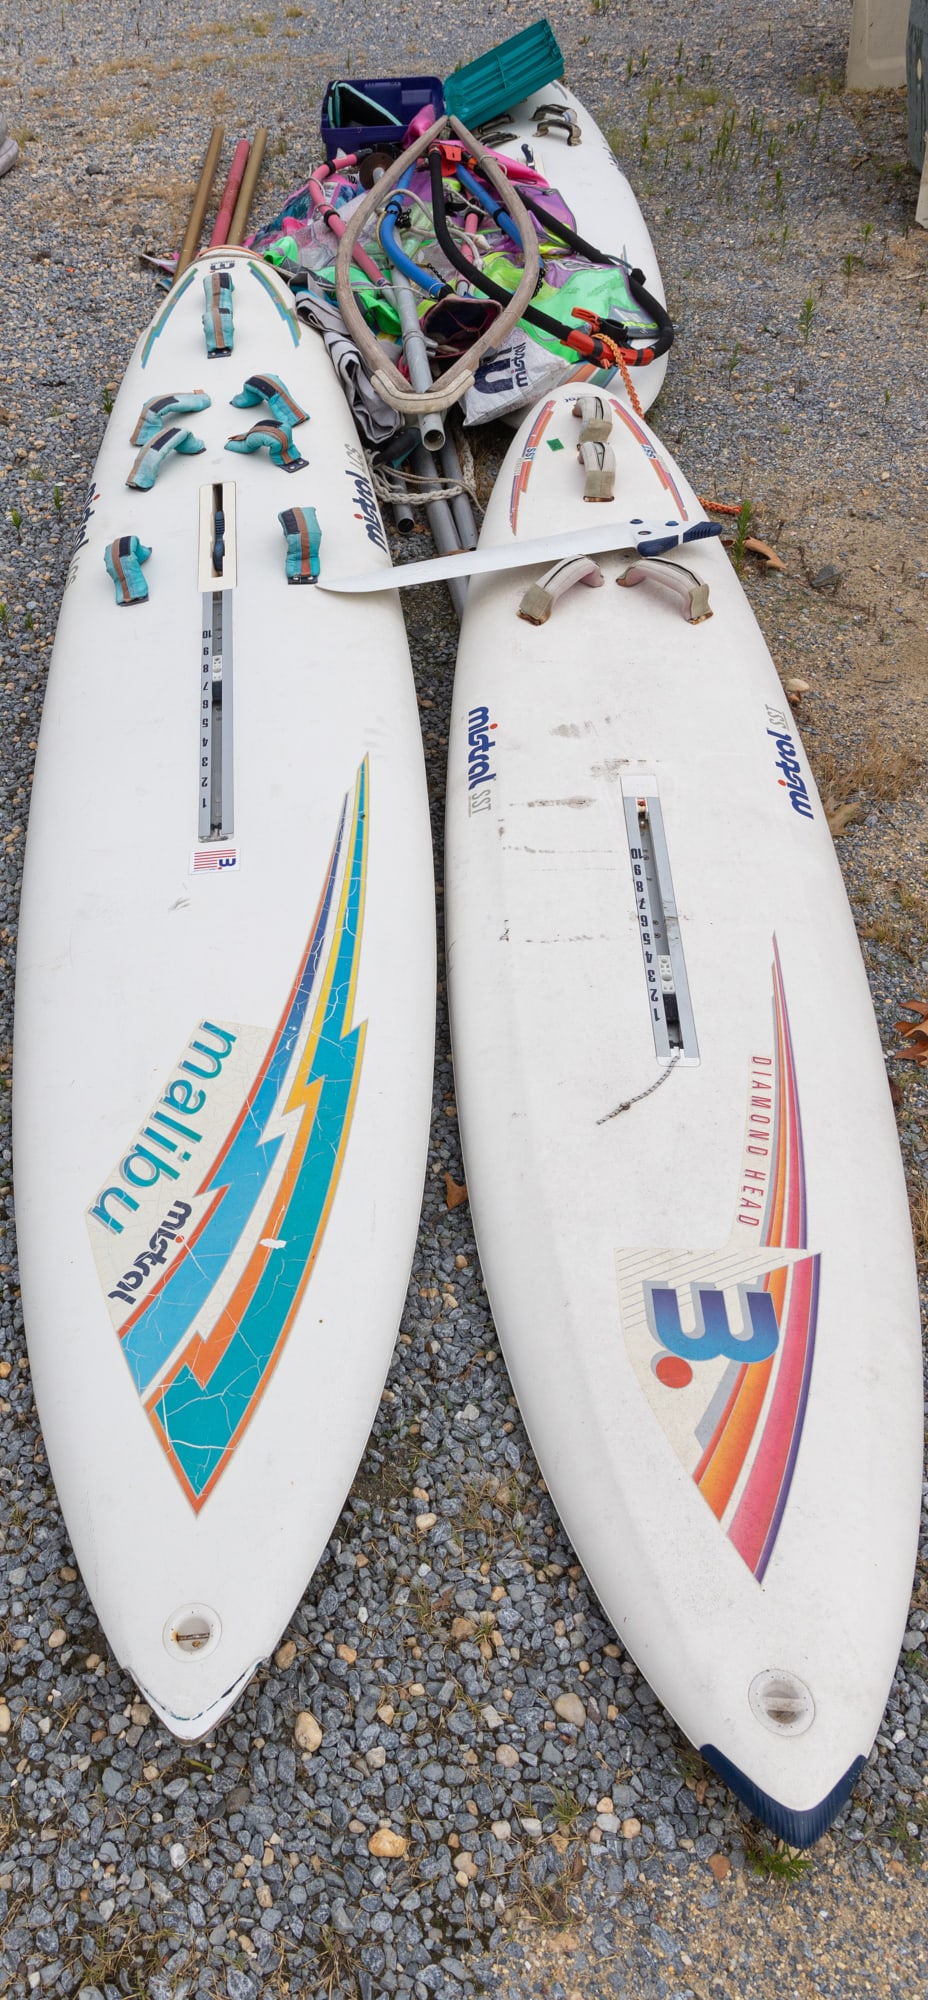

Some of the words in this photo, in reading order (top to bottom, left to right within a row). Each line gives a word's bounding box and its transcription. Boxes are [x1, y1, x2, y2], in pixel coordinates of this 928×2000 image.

[345, 469, 388, 554] mistral
[202, 629, 212, 639] 10
[203, 646, 209, 655] 9
[202, 664, 209, 673] 8
[202, 681, 209, 691] 7
[202, 699, 209, 709] 6
[765, 704, 787, 729] SST
[202, 718, 209, 728] 5
[202, 737, 208, 747] 4
[468, 706, 498, 791] mistral
[201, 756, 208, 767] 3
[767, 729, 814, 820] mistral
[201, 777, 208, 787] 2
[202, 798, 207, 808] 1
[471, 789, 492, 815] SST
[630, 848, 643, 859] 10
[634, 864, 642, 876] 9
[636, 881, 644, 892] 8
[639, 898, 646, 910] 7
[640, 915, 648, 927] 6
[642, 932, 651, 945] 5
[645, 950, 653, 964] 4
[647, 969, 656, 983] 3
[649, 988, 659, 1002] 2
[653, 1008, 660, 1022] 1
[747, 1056, 772, 1157] DIAMOND
[88, 1021, 237, 1234] malibu
[738, 1168, 767, 1227] HEAD
[108, 1200, 192, 1305] mistral
